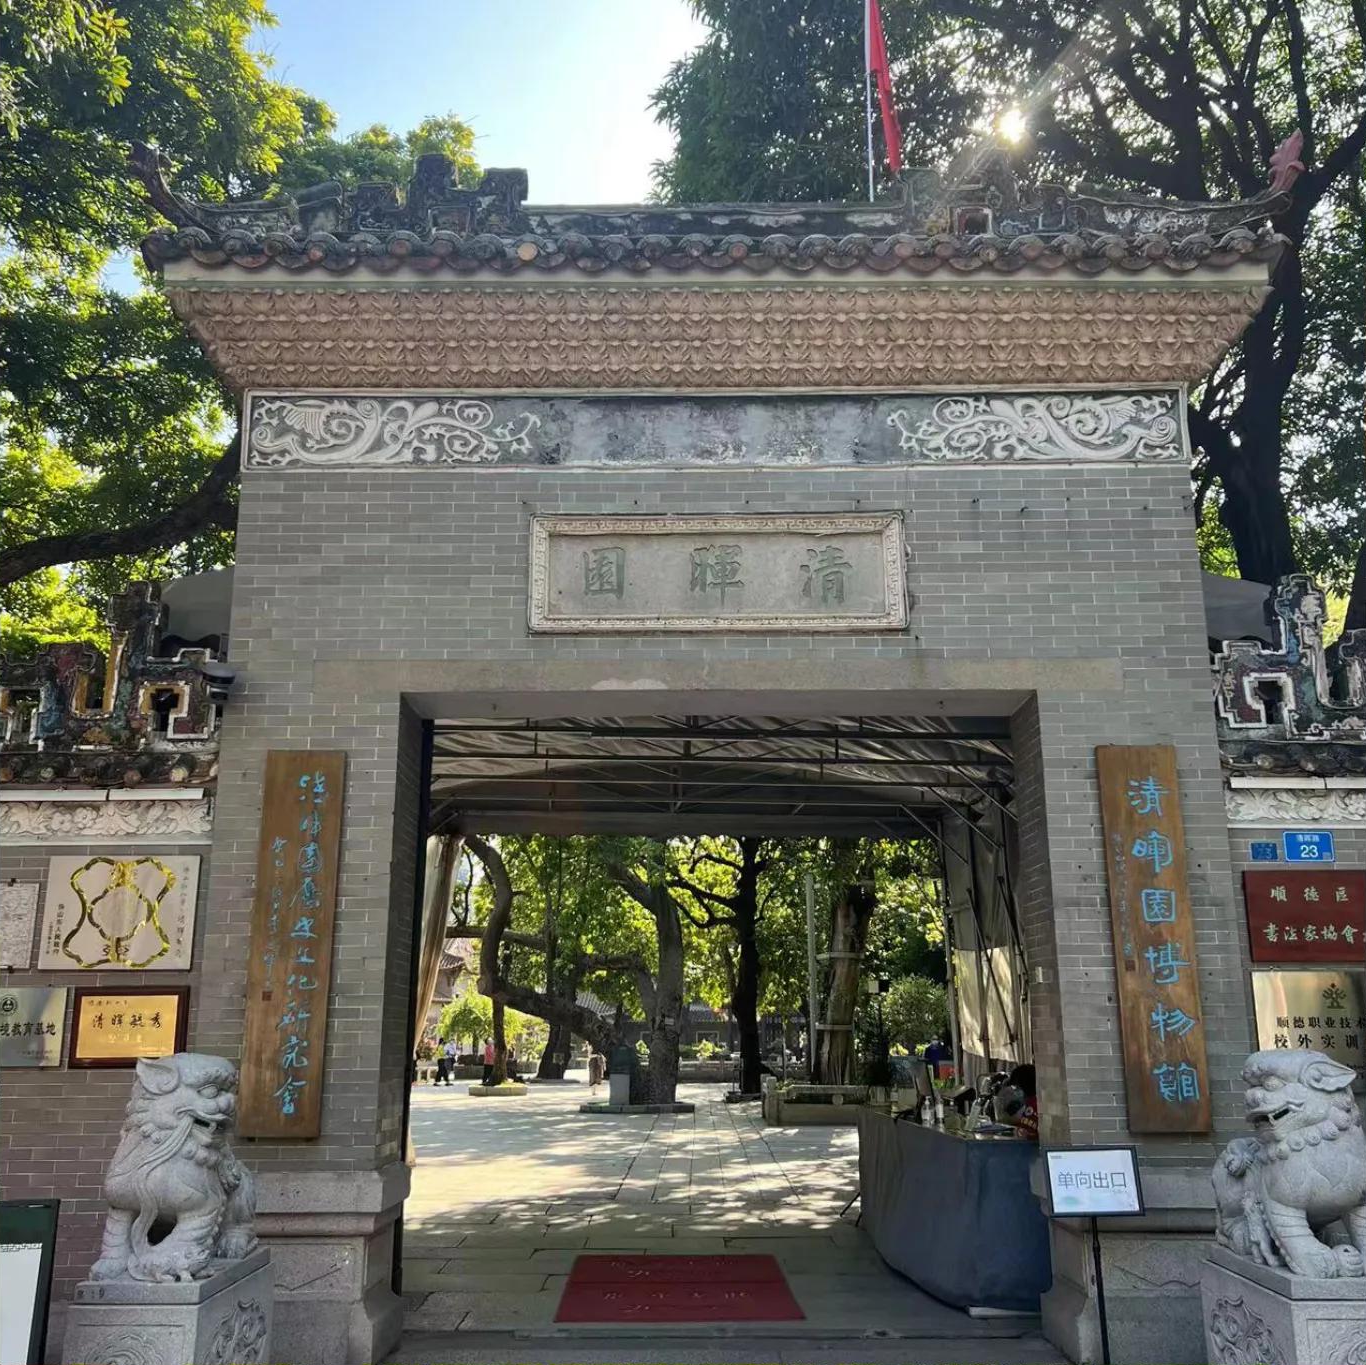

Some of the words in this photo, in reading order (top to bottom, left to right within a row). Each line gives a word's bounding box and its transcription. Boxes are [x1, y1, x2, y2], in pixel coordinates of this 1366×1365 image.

[1300, 845, 1319, 858] 23
[1262, 922, 1366, 945] 書法家協會
[1058, 1171, 1127, 1190] 单向出口
